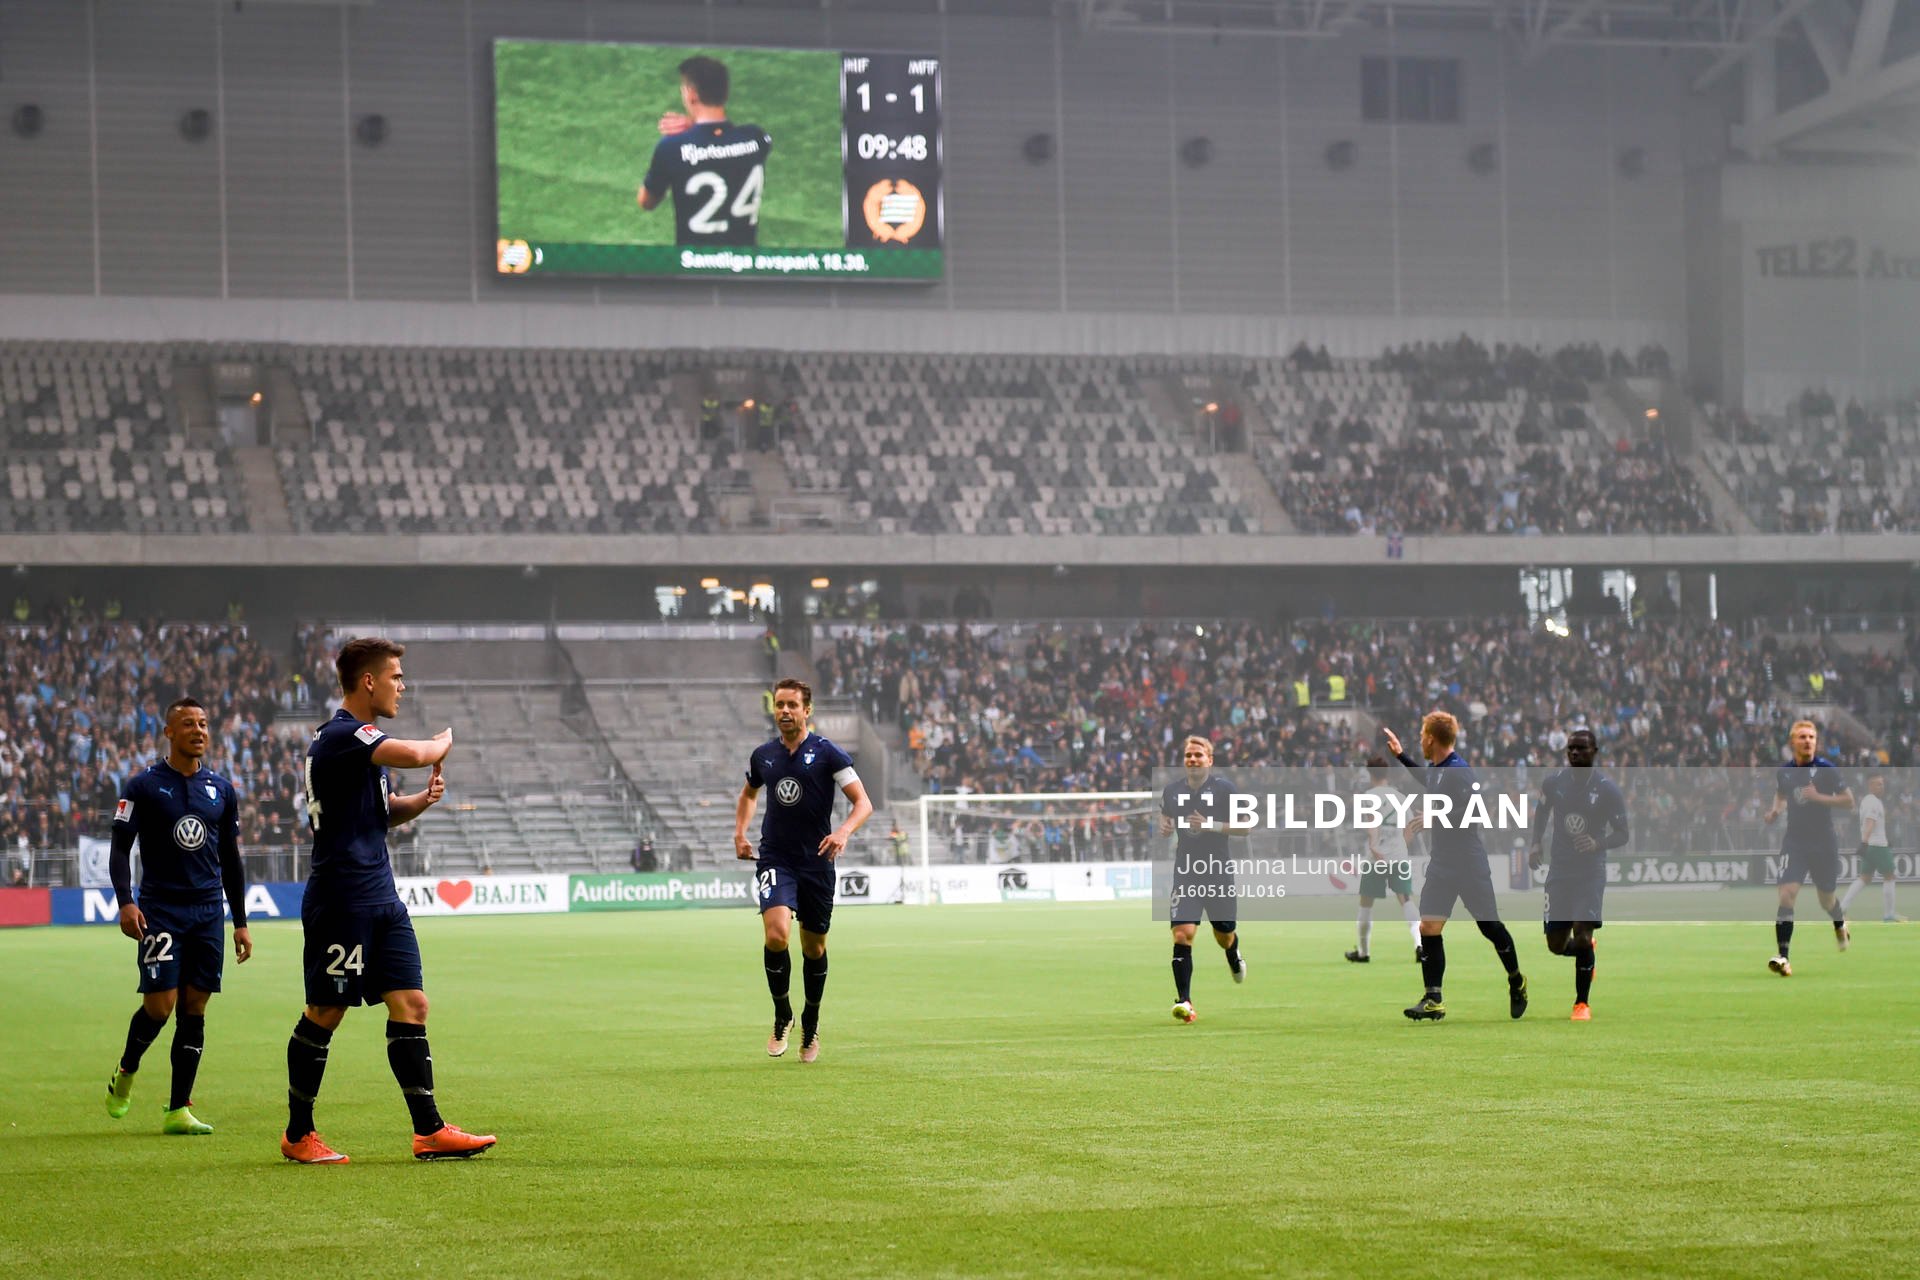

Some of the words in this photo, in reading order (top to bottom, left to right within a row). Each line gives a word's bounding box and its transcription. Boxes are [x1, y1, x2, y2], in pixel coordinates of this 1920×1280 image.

[857, 82, 870, 112] 1
[910, 83, 924, 114] 1
[858, 133, 927, 162] 09:48
[685, 165, 764, 233] 24
[680, 250, 753, 272] Samtliga
[755, 252, 820, 273] avspark
[1755, 236, 1858, 279] TELE2
[759, 868, 777, 890] 21
[1627, 858, 1748, 882] JÄGAREN
[474, 884, 548, 905] BAJEN
[572, 876, 747, 902] AudicomPendax
[143, 932, 174, 964] 22
[326, 944, 365, 976] 24
